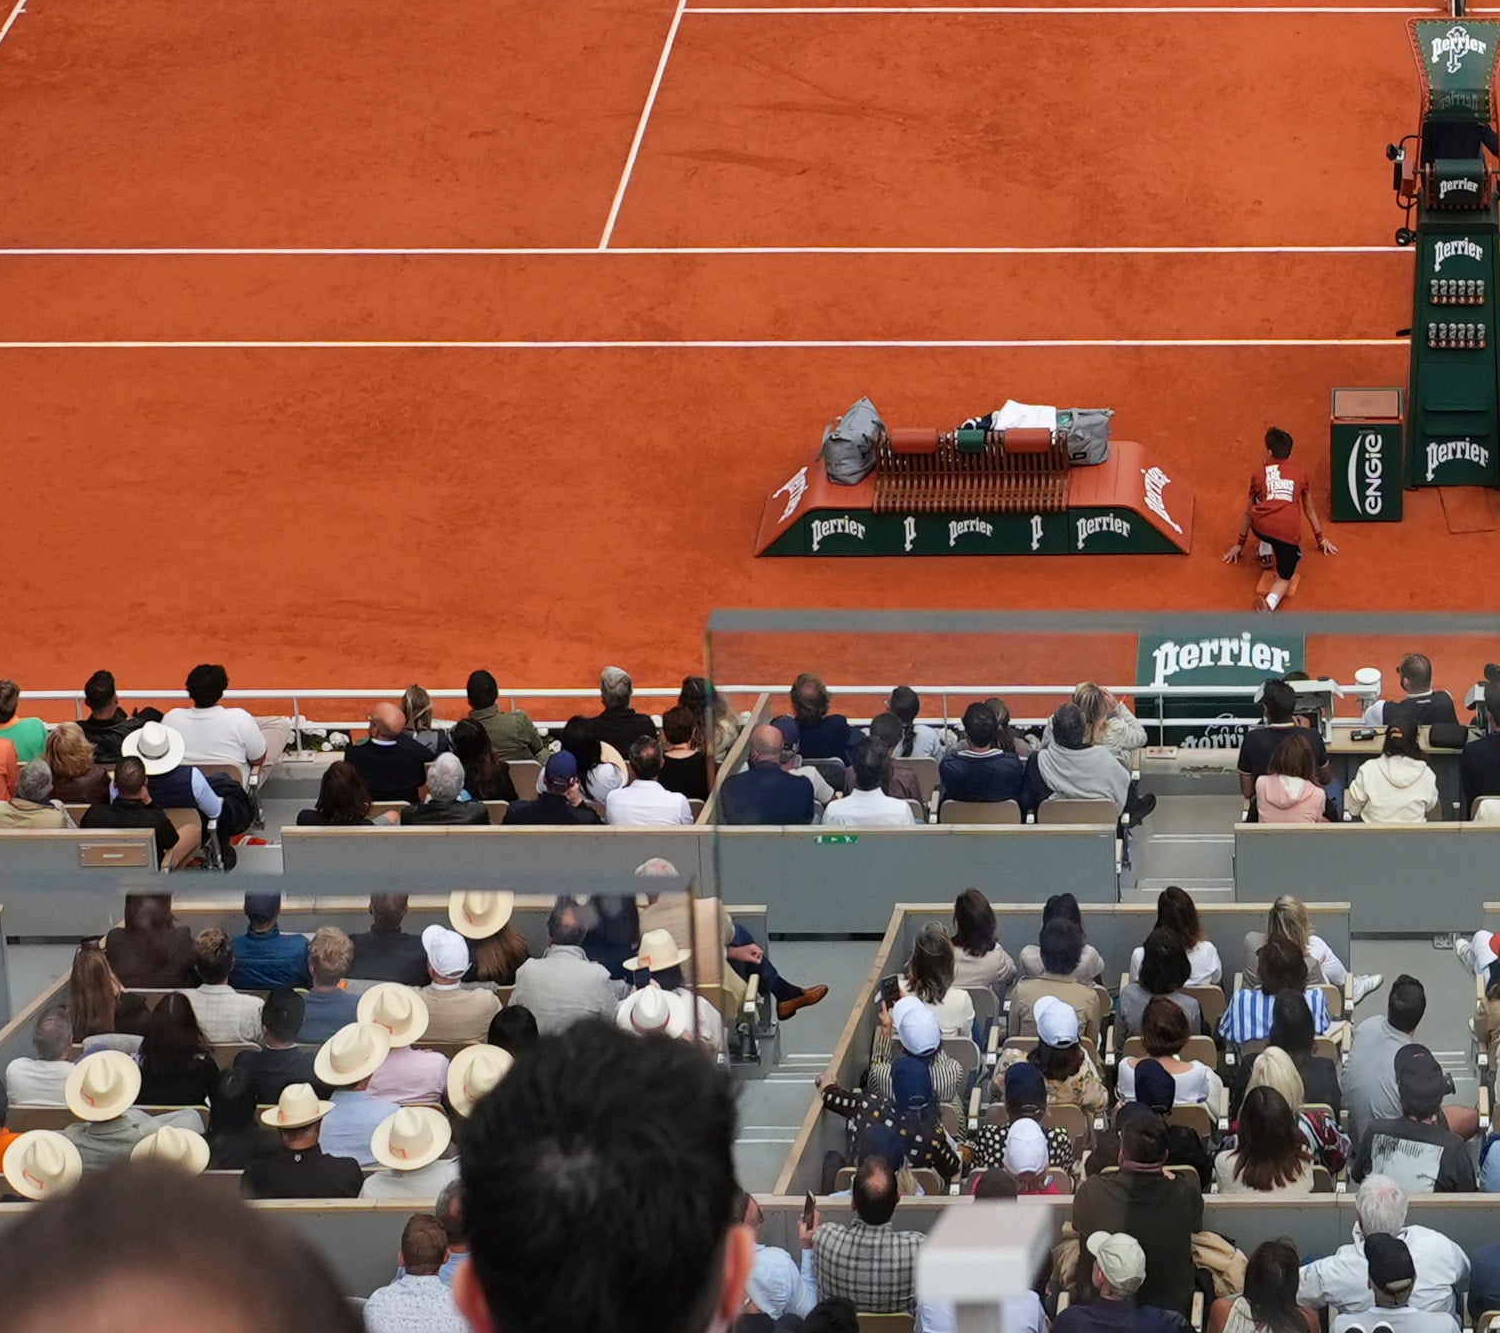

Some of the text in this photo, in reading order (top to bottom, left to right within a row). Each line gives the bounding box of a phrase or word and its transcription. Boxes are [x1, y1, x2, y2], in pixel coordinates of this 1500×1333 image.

[1439, 177, 1478, 199] perrier
[1434, 237, 1483, 272] perrier
[1425, 437, 1489, 482] perrier
[811, 515, 865, 551] perrier
[948, 516, 993, 547] perrier
[1076, 513, 1130, 550] perrier
[1152, 632, 1291, 687] perrier
